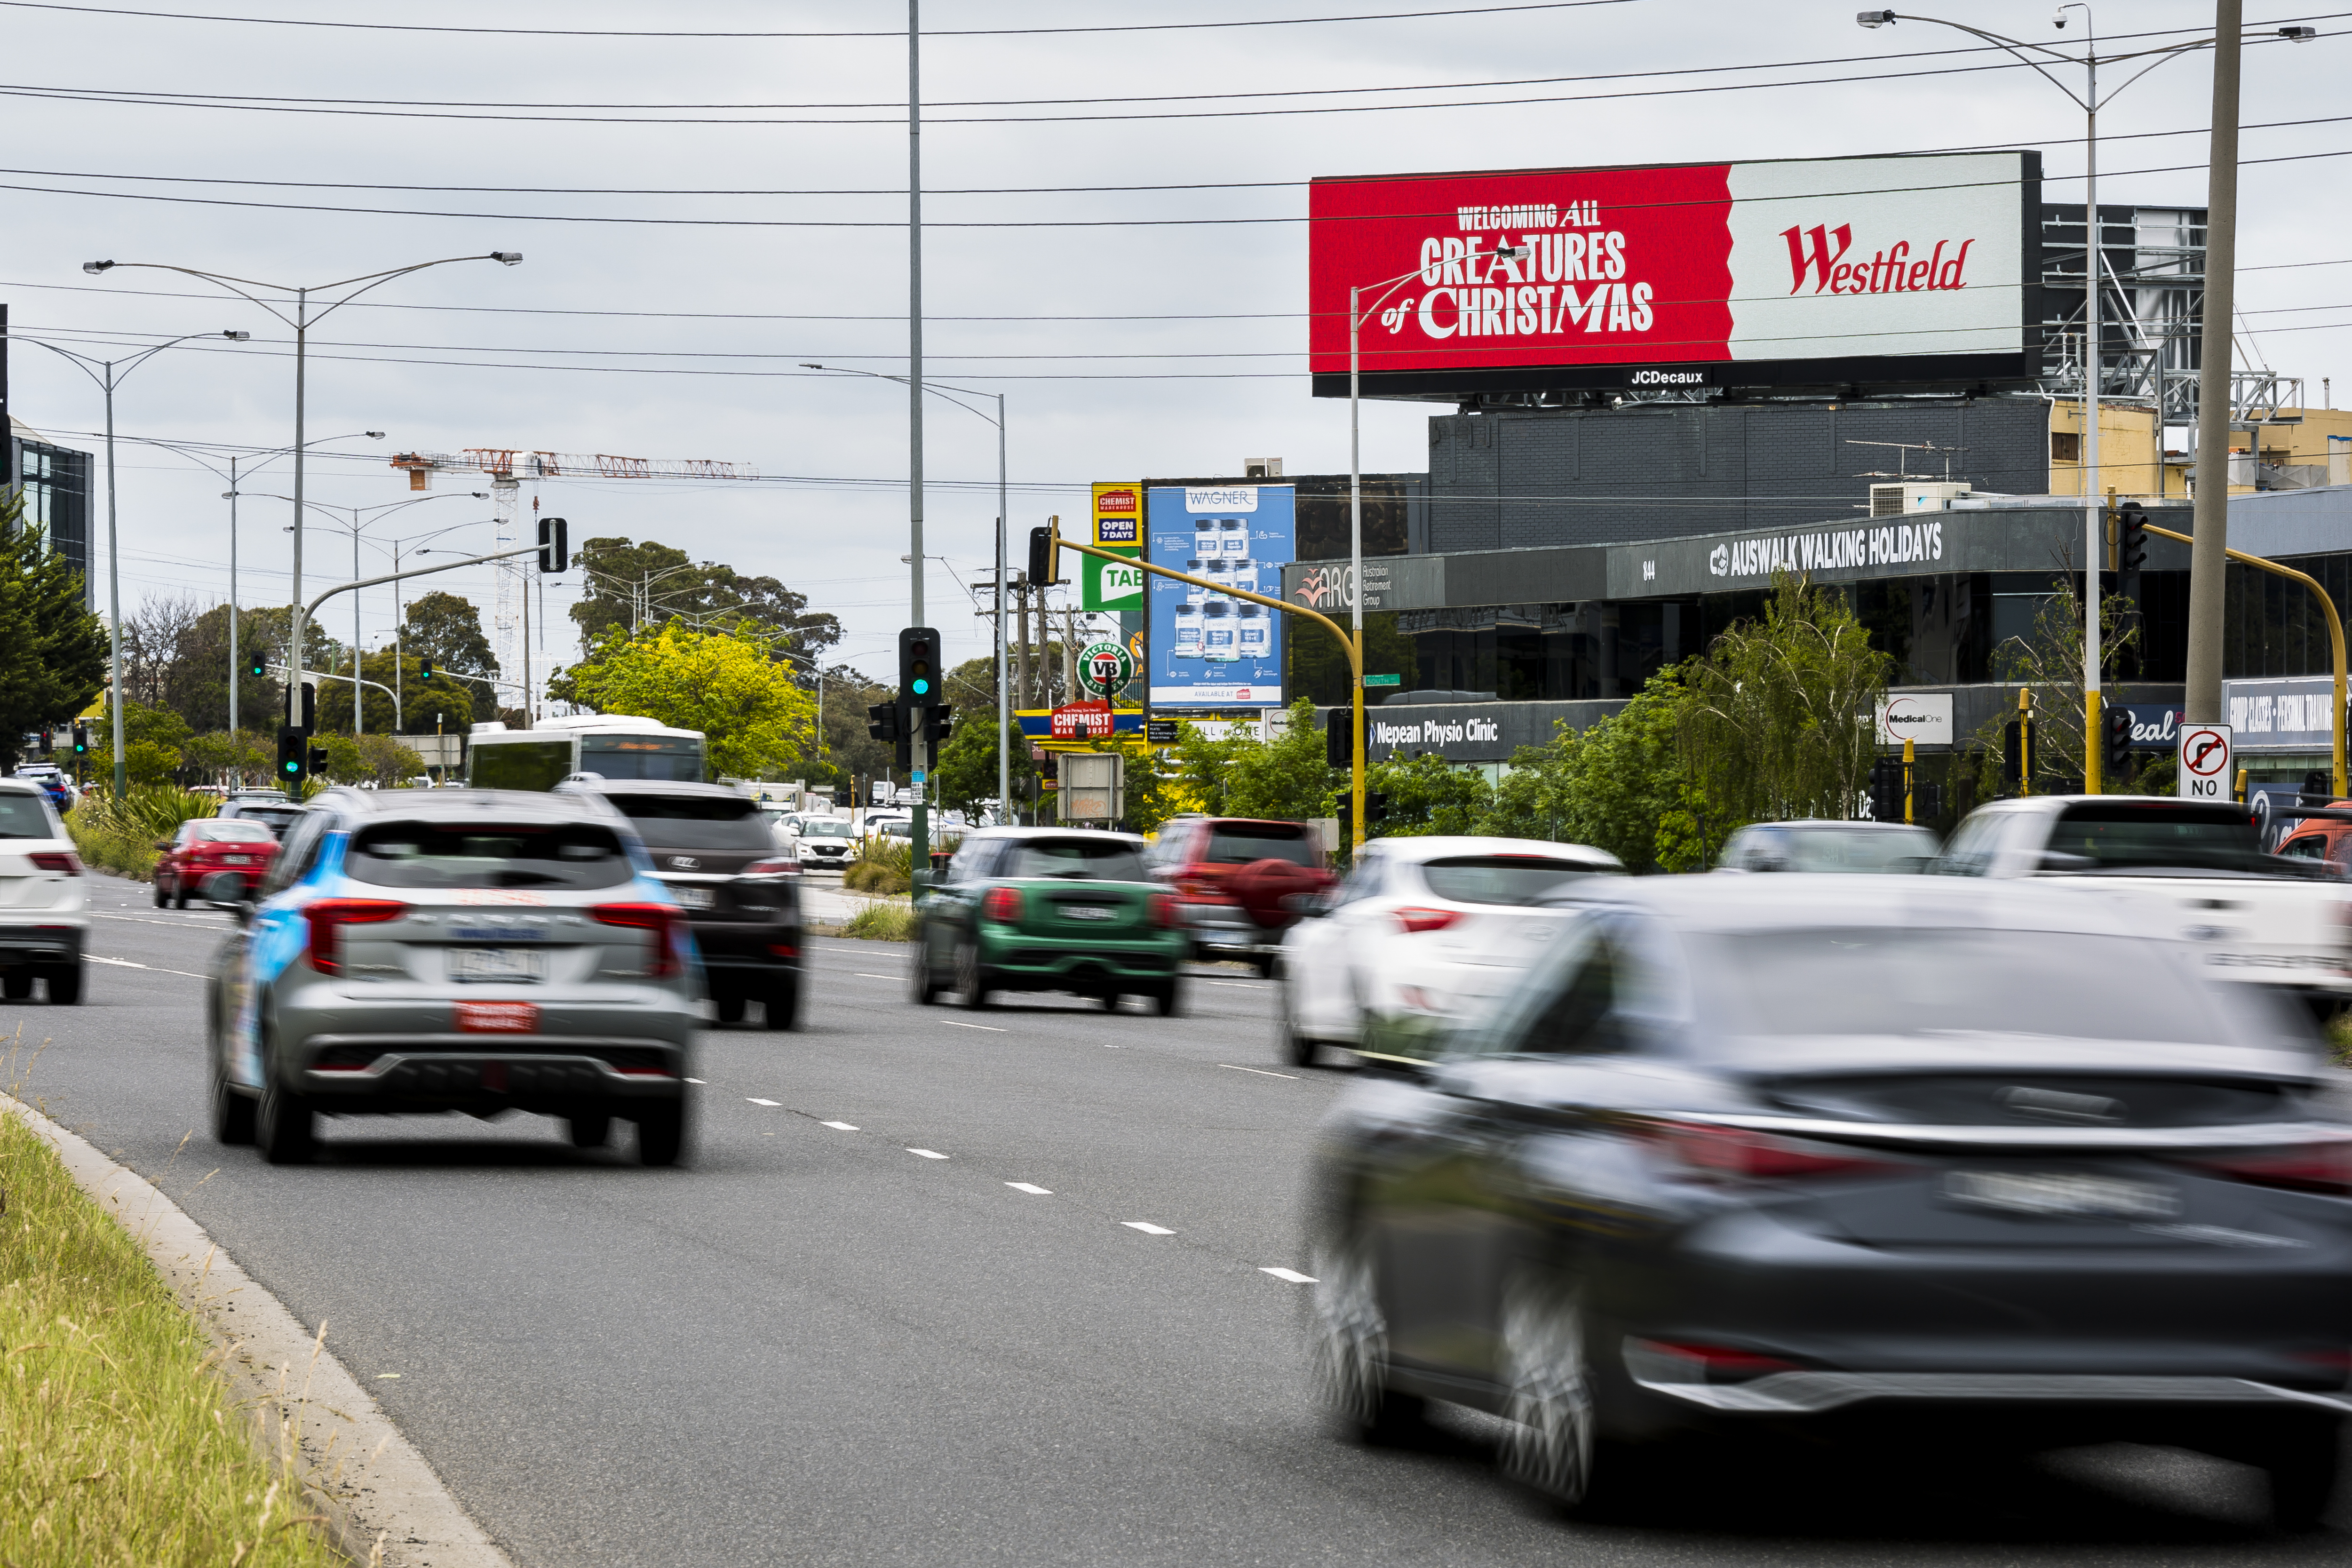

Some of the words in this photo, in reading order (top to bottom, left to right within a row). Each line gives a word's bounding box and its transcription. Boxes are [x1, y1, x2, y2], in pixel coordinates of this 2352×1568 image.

[1458, 203, 1557, 230] WELCOMING
[1560, 199, 1601, 227] ALL
[1420, 231, 1626, 287] CREATURES
[1779, 223, 1975, 295] Westfield
[1381, 298, 1414, 334] of
[1418, 282, 1653, 339] CHRISTMAS
[1632, 371, 1703, 384] JCDecaux
[1190, 491, 1253, 505] WAGNER
[1102, 521, 1133, 530] OPEN
[1731, 535, 1797, 576] AUSWALK
[1800, 529, 1866, 571] WALKING
[1869, 522, 1942, 565] HOLIDAYS
[1106, 570, 1142, 587] TAB
[1643, 560, 1655, 581] 844
[1319, 566, 1353, 608] ARG
[1363, 565, 1388, 577] Australian
[1363, 579, 1391, 591] Retirement
[1363, 594, 1380, 608] Group
[1083, 645, 1127, 662] VICTORIA
[1092, 661, 1118, 676] VB
[1087, 679, 1124, 692] BITER
[1054, 713, 1110, 726] CHEMIST
[1889, 714, 1942, 723] MedicalOne
[2230, 697, 2248, 733] GROUP
[2249, 695, 2272, 733] CLASSES
[2277, 694, 2305, 732] PERSONAL
[2306, 694, 2333, 731] TRAINING
[1377, 722, 1421, 748] Nepean
[1424, 719, 1463, 748] Physio
[1466, 717, 1498, 741] Clinic
[2192, 779, 2217, 796] NO
